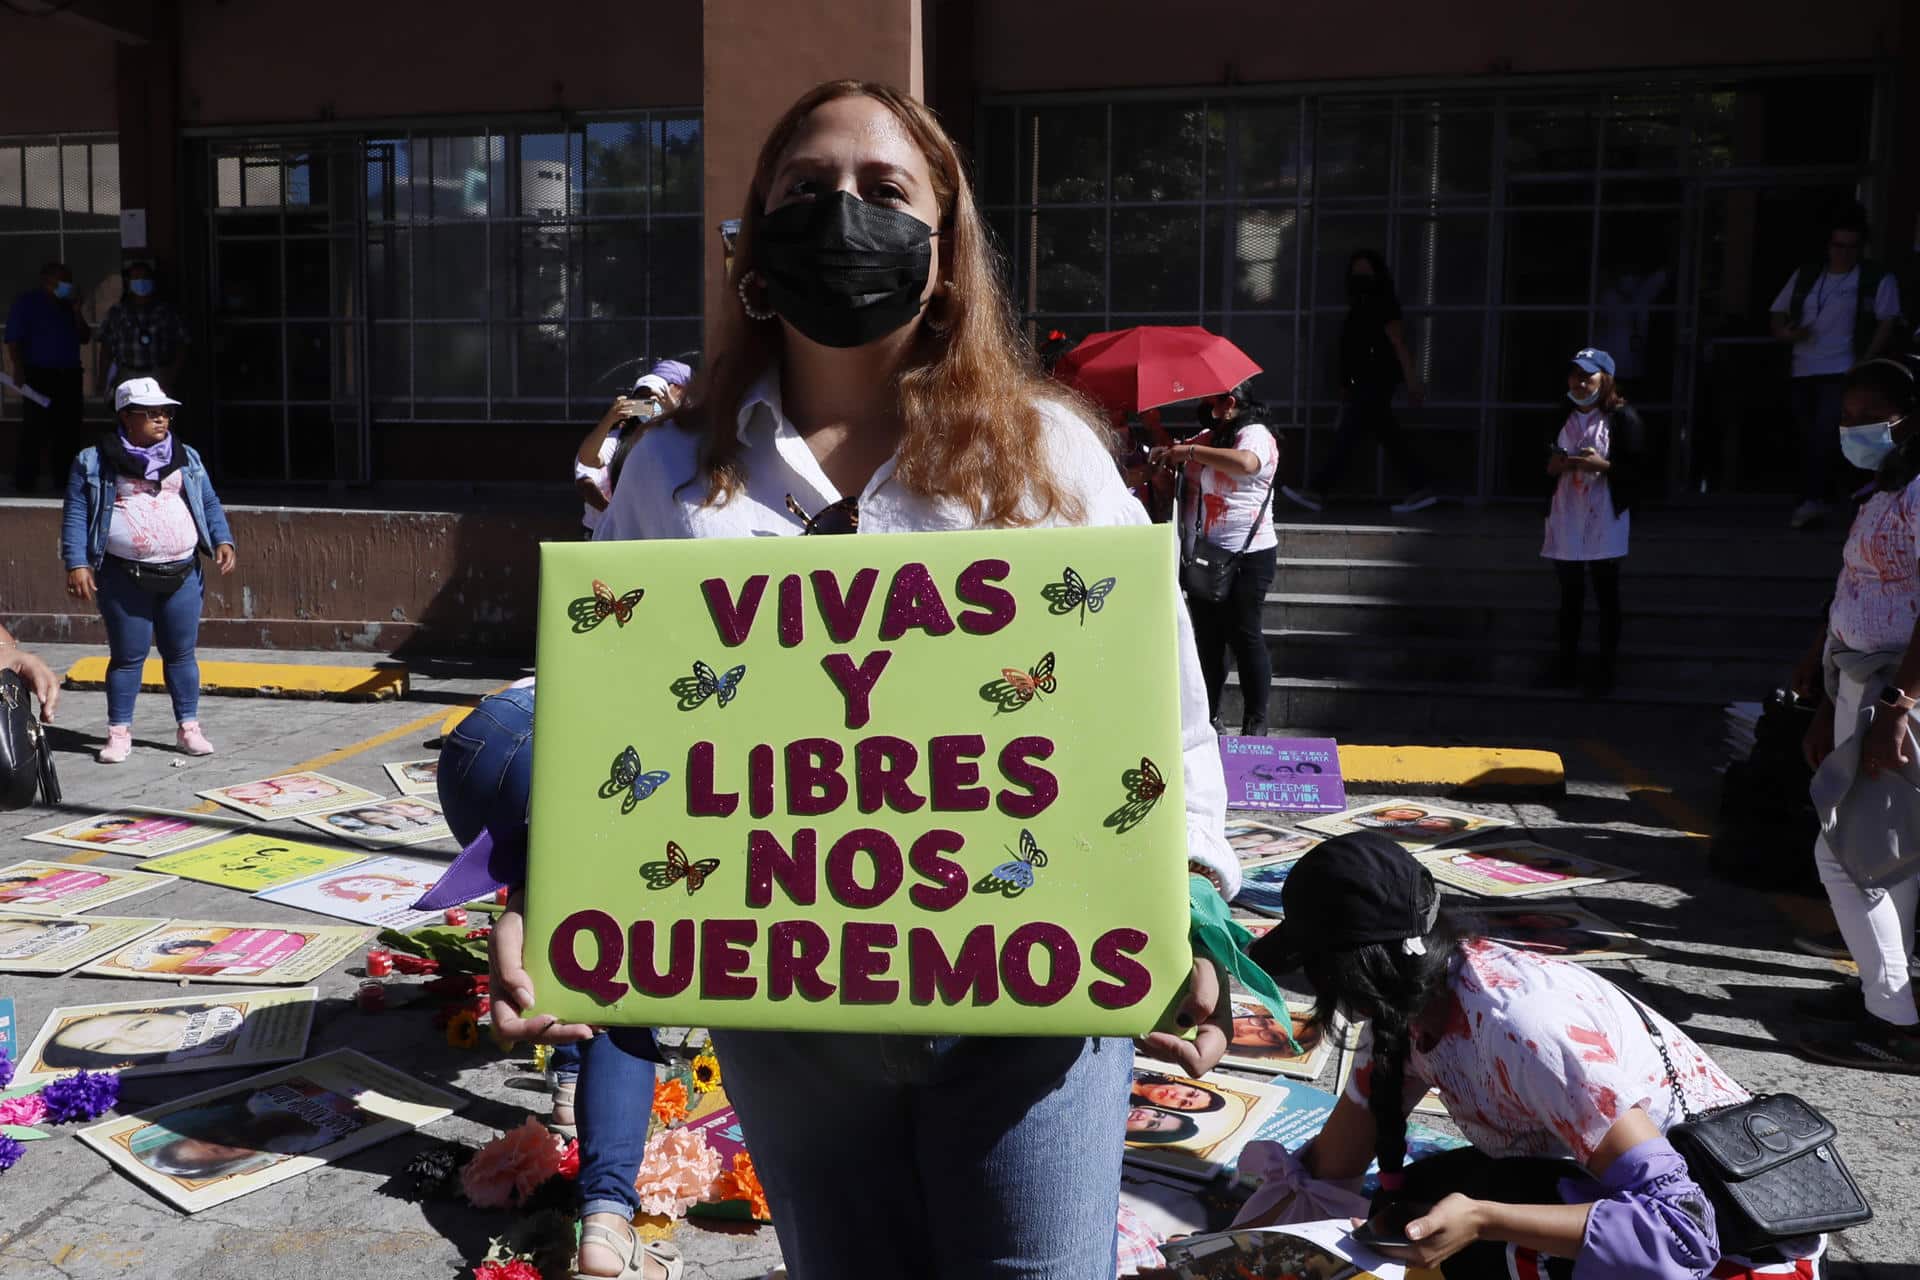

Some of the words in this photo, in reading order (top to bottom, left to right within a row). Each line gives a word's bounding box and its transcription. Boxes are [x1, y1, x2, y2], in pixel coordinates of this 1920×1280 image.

[704, 559, 1017, 647] VIVAS
[826, 650, 892, 729] Y
[688, 735, 1059, 818] LIBRES
[1245, 782, 1319, 793] FLORECEMOS
[1246, 791, 1270, 801] CON
[1273, 791, 1289, 801] LA
[1293, 792, 1320, 803] VIDA
[747, 828, 969, 912] NOS
[548, 909, 1153, 1009] QUEREMOS
